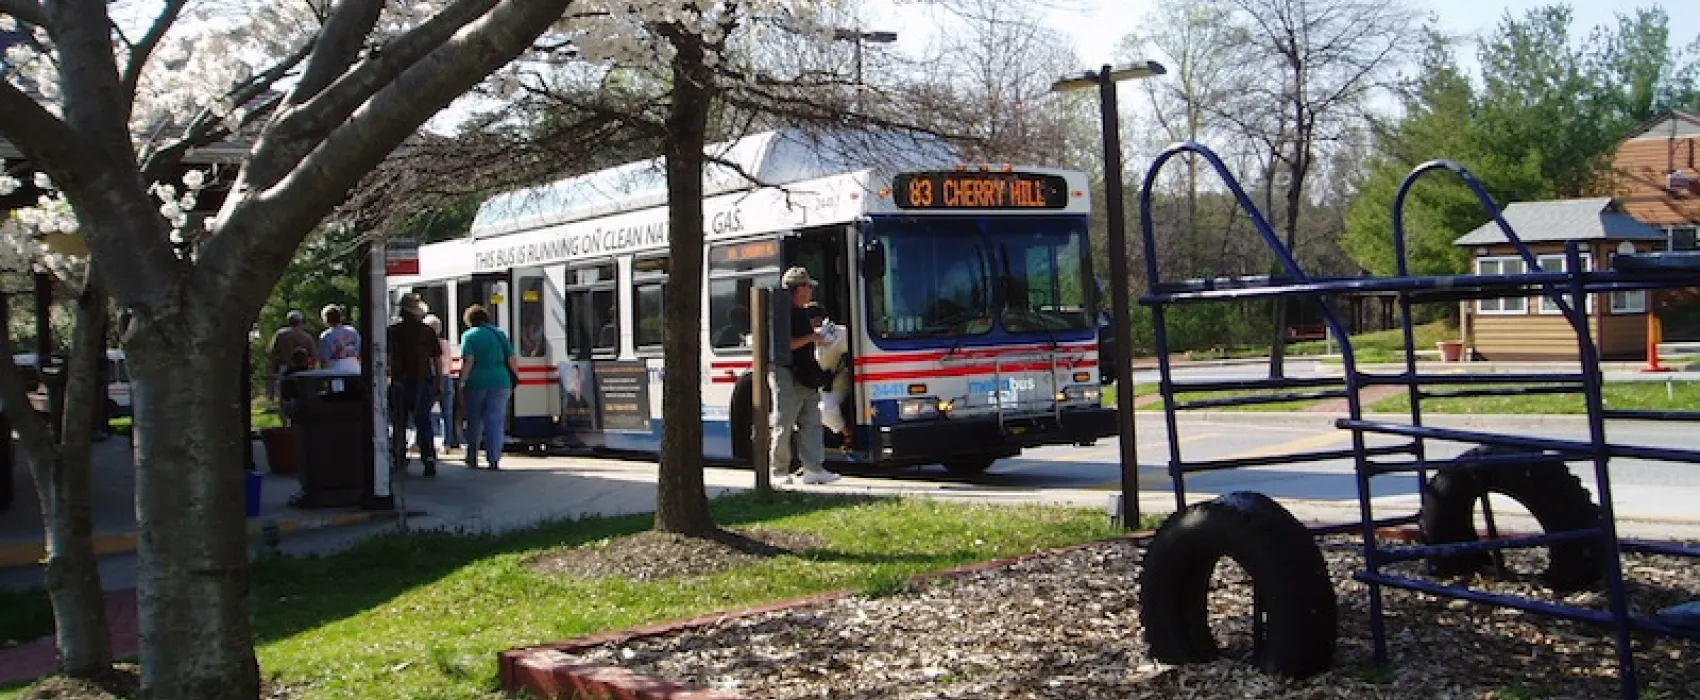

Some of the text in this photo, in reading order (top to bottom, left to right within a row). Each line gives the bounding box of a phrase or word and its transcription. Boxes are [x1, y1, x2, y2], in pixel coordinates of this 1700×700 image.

[909, 178, 1046, 207] 83 CHERRY HILL
[475, 249, 494, 268] THIS
[497, 245, 515, 267] BUS
[516, 244, 526, 264] IS
[528, 235, 579, 263] RUNNING
[581, 228, 600, 254] ON
[603, 223, 644, 250] CLEAN
